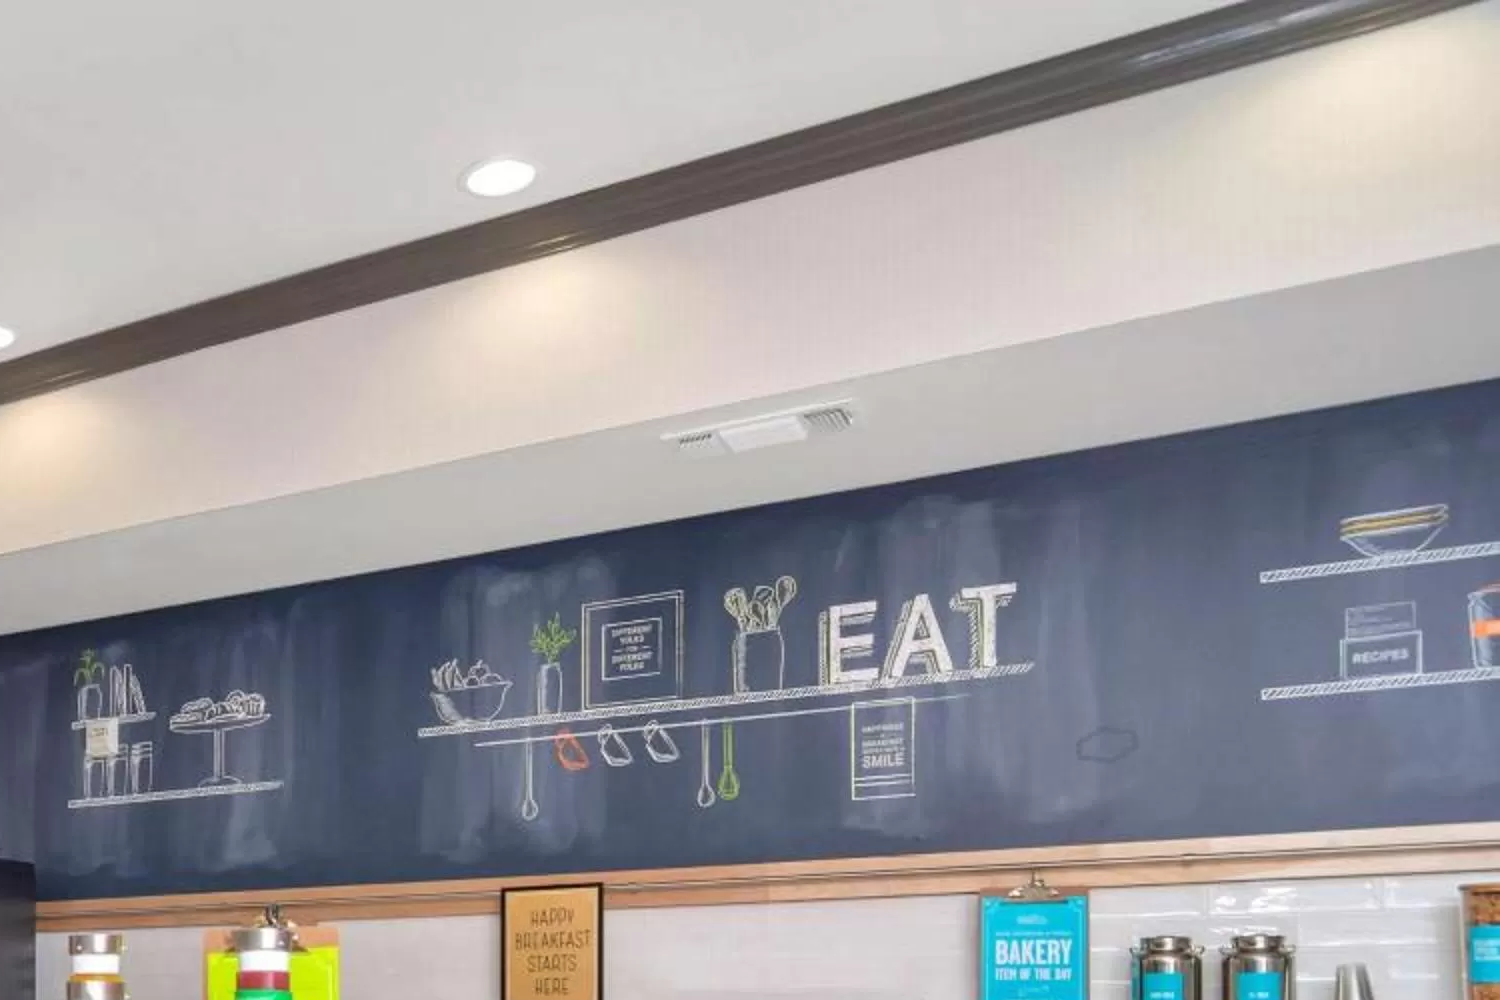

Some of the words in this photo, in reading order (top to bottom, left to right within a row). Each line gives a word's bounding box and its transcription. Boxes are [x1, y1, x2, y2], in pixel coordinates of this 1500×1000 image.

[819, 582, 1017, 685] EAT
[1352, 647, 1410, 664] RECIPES
[862, 752, 905, 769] SMILE
[530, 907, 575, 928] HAPPY
[515, 929, 591, 950] BREAKFAST
[995, 939, 1073, 965] BAKERY
[526, 953, 577, 973] STARTS
[535, 977, 569, 996] HERE
